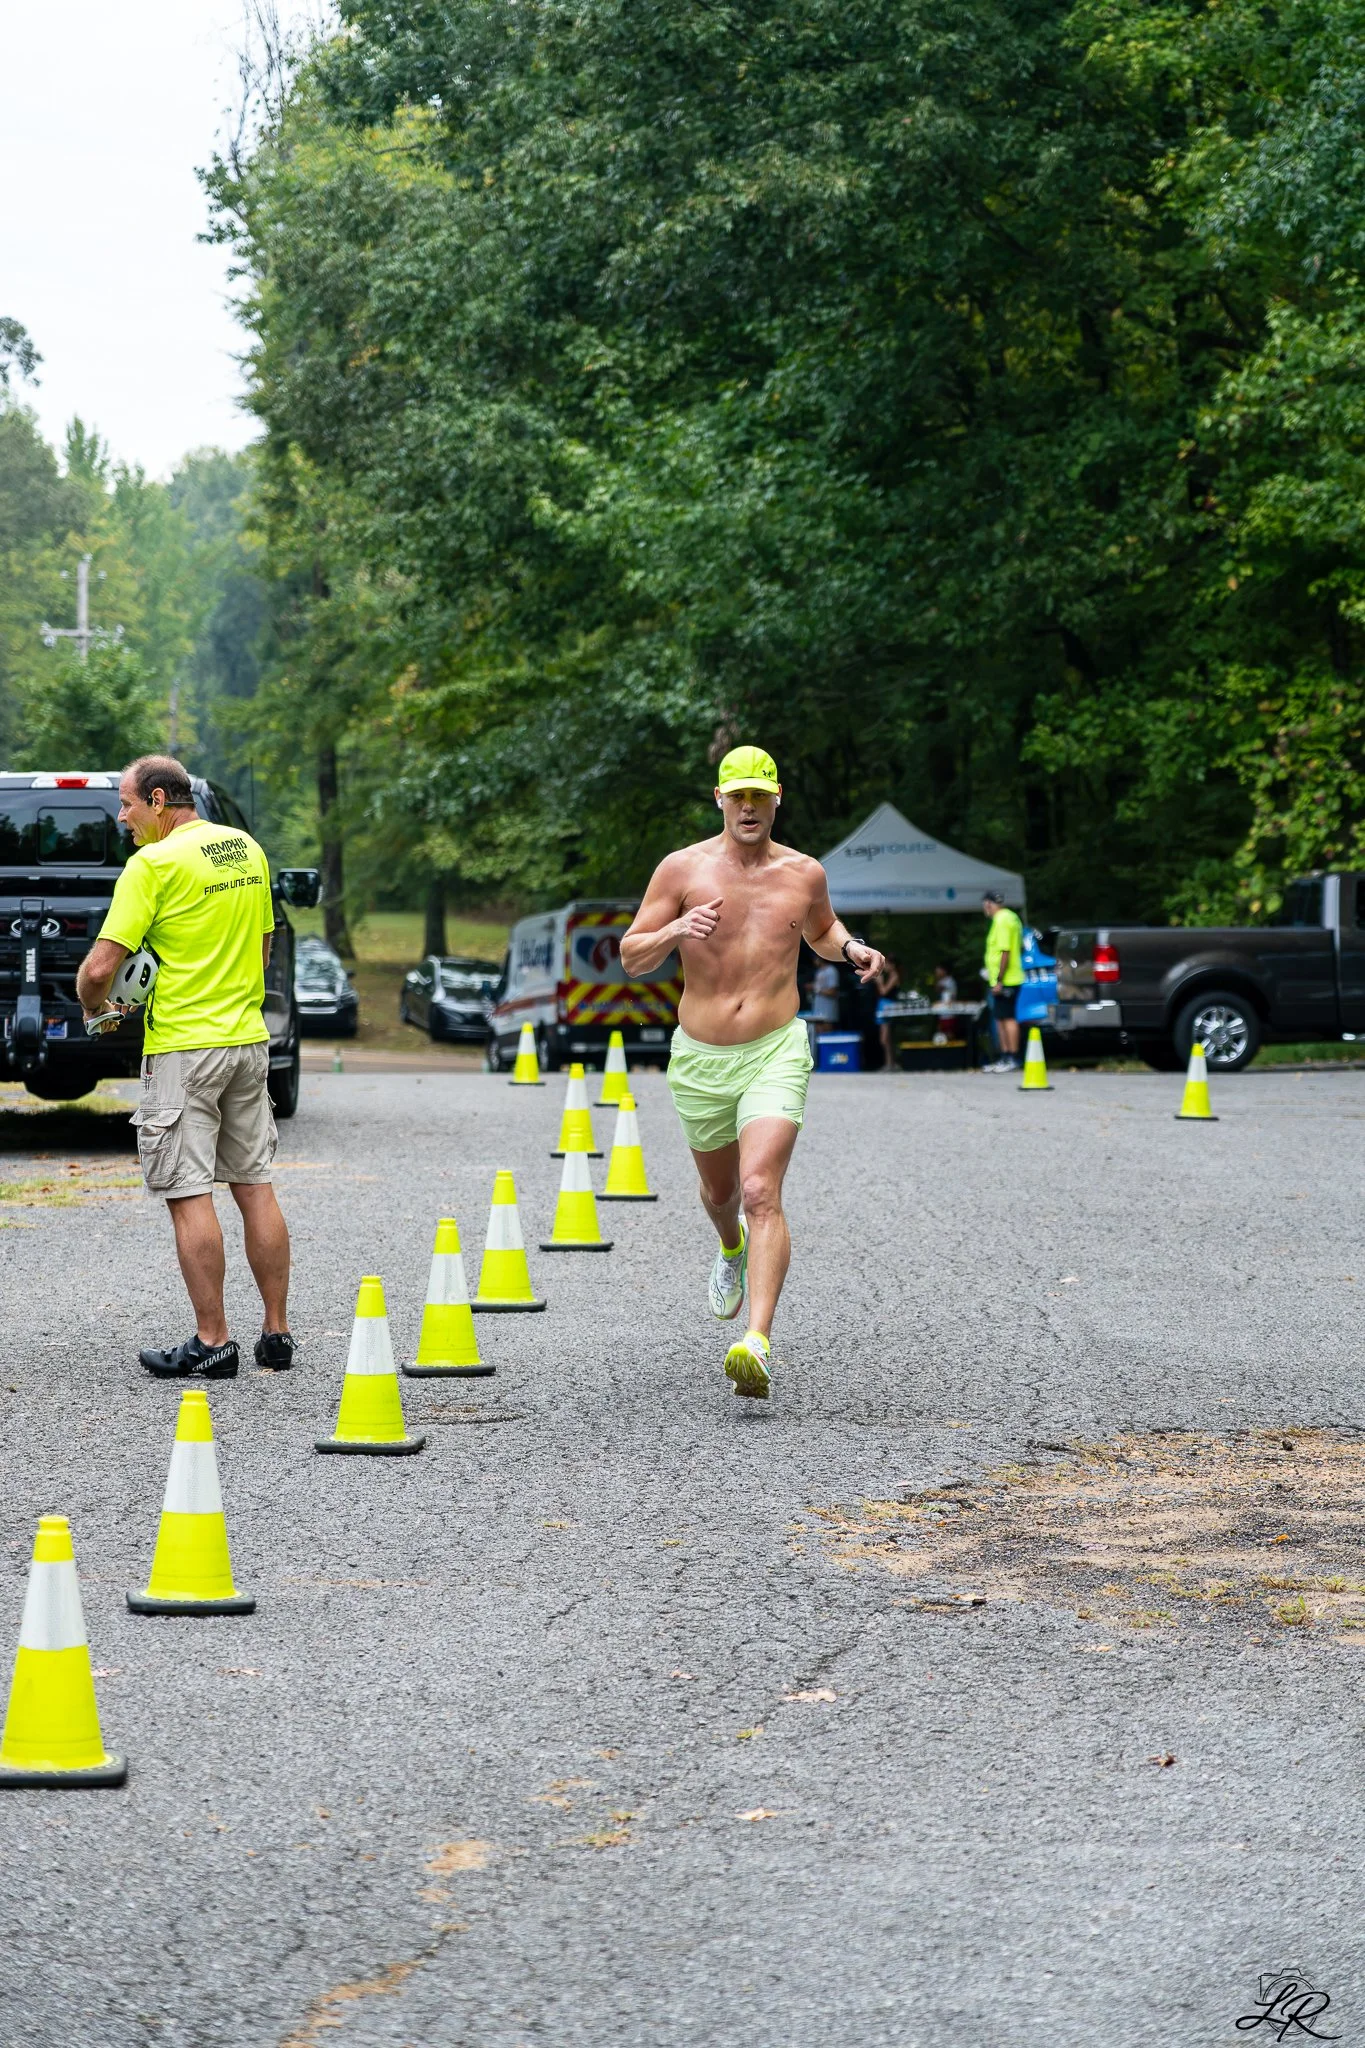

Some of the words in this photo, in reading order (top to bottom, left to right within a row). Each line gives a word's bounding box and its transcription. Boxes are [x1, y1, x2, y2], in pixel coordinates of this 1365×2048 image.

[200, 838, 247, 857] MEMPHIS
[210, 850, 247, 865] RUNNERS
[204, 881, 229, 896] FINISH
[230, 877, 246, 889] LINE
[26, 947, 36, 983] THULE
